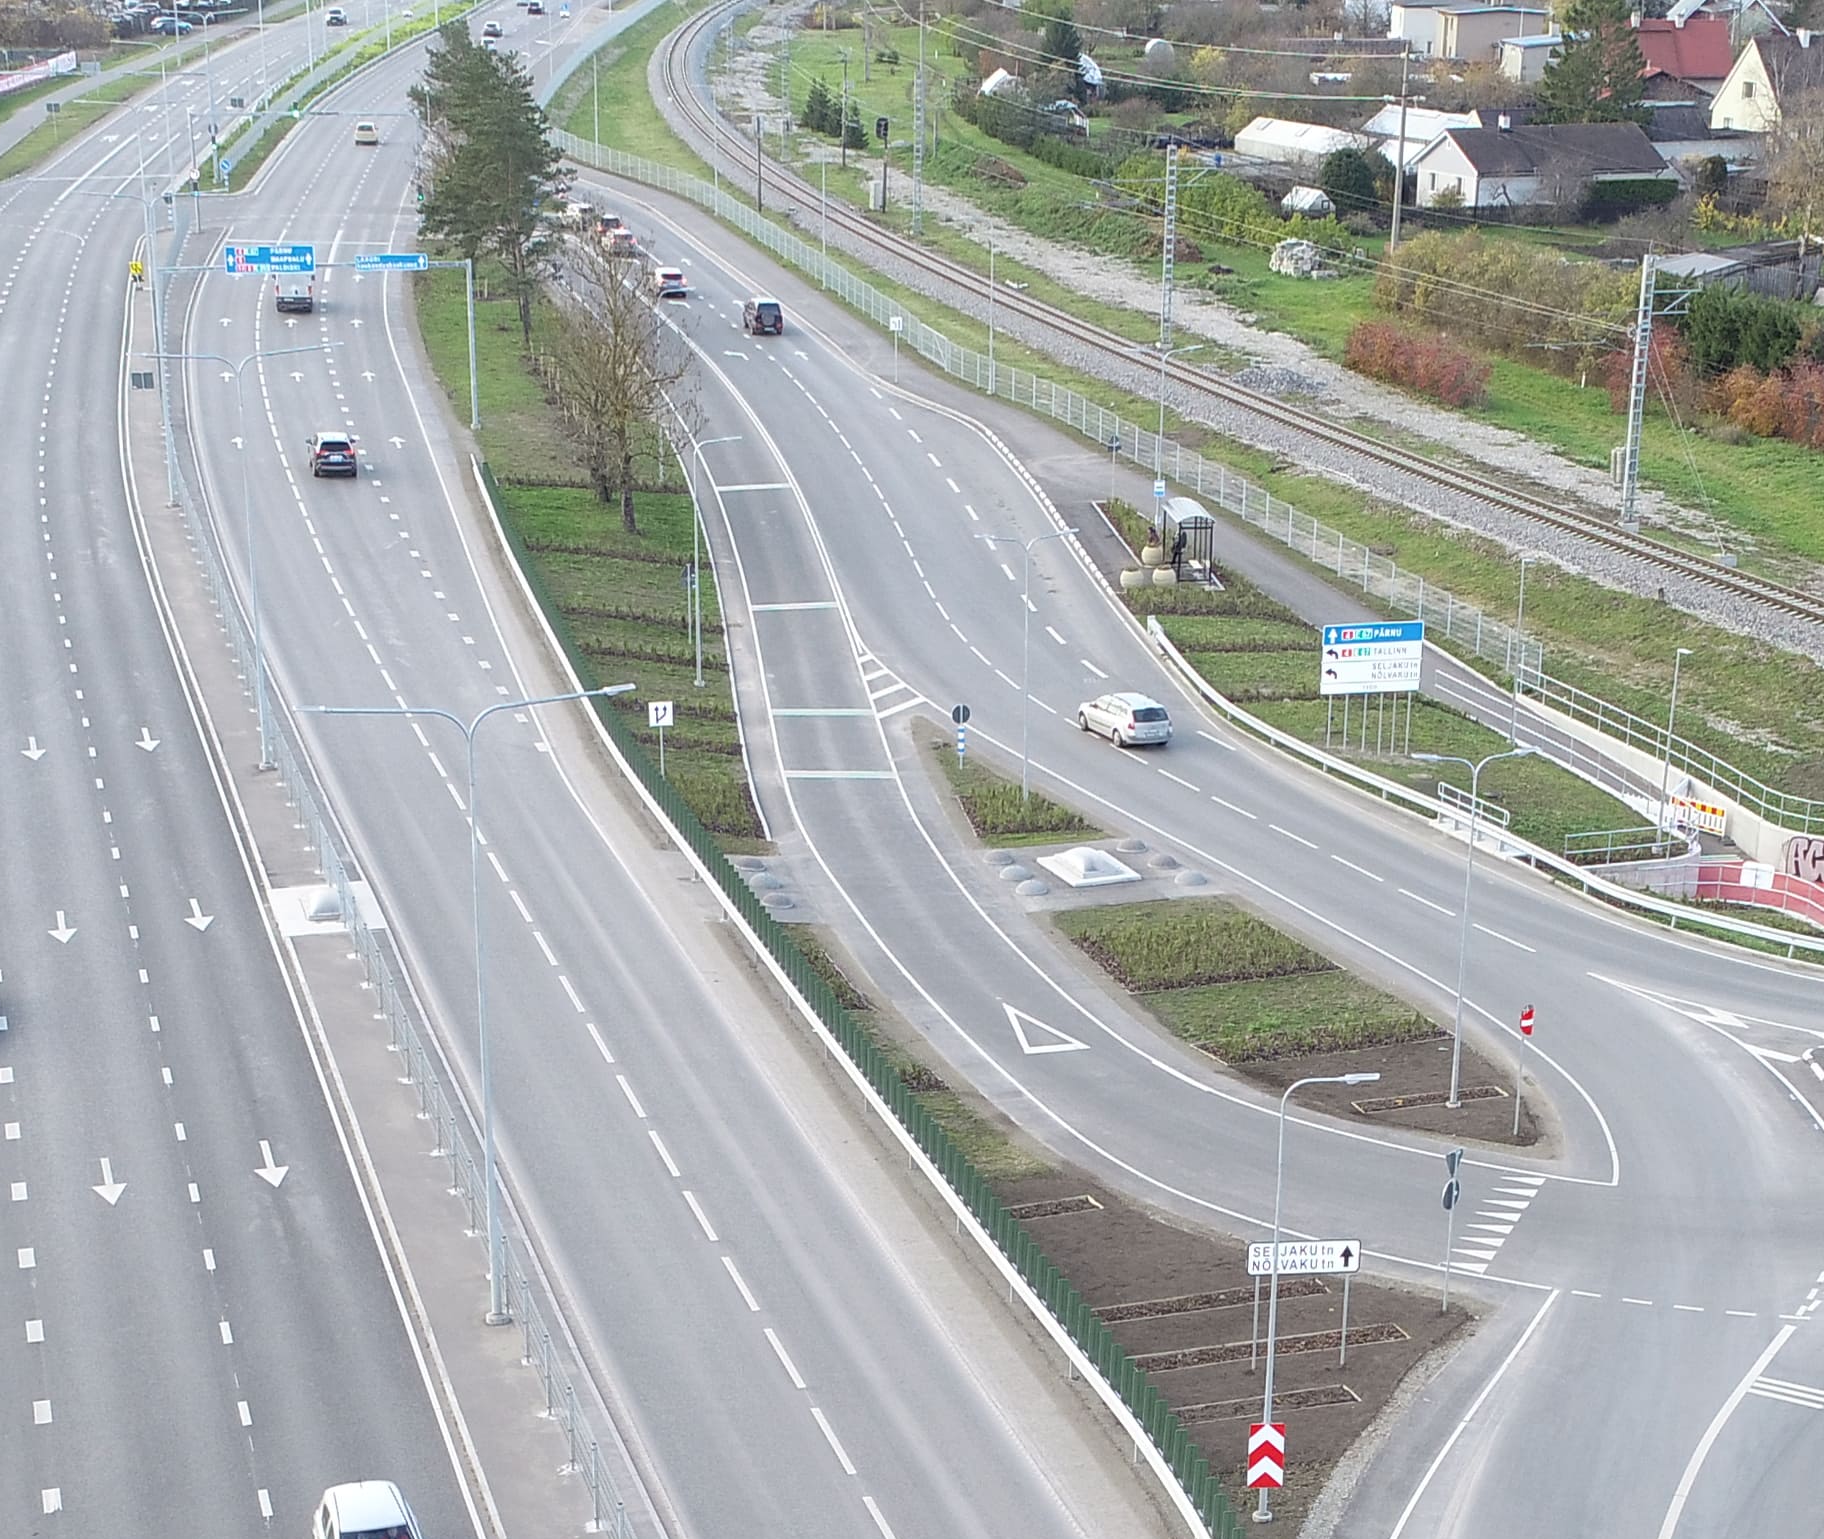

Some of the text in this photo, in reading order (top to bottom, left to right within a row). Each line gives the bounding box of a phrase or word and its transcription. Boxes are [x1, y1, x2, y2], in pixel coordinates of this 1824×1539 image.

[1374, 627, 1402, 638] PÄRNU
[1374, 647, 1407, 655] TALLINN
[1372, 661, 1409, 670] SELJAKU
[1371, 671, 1409, 679] NÕLVAKU
[1253, 1245, 1334, 1258] SEJAKU tn
[1321, 1259, 1334, 1269] tn
